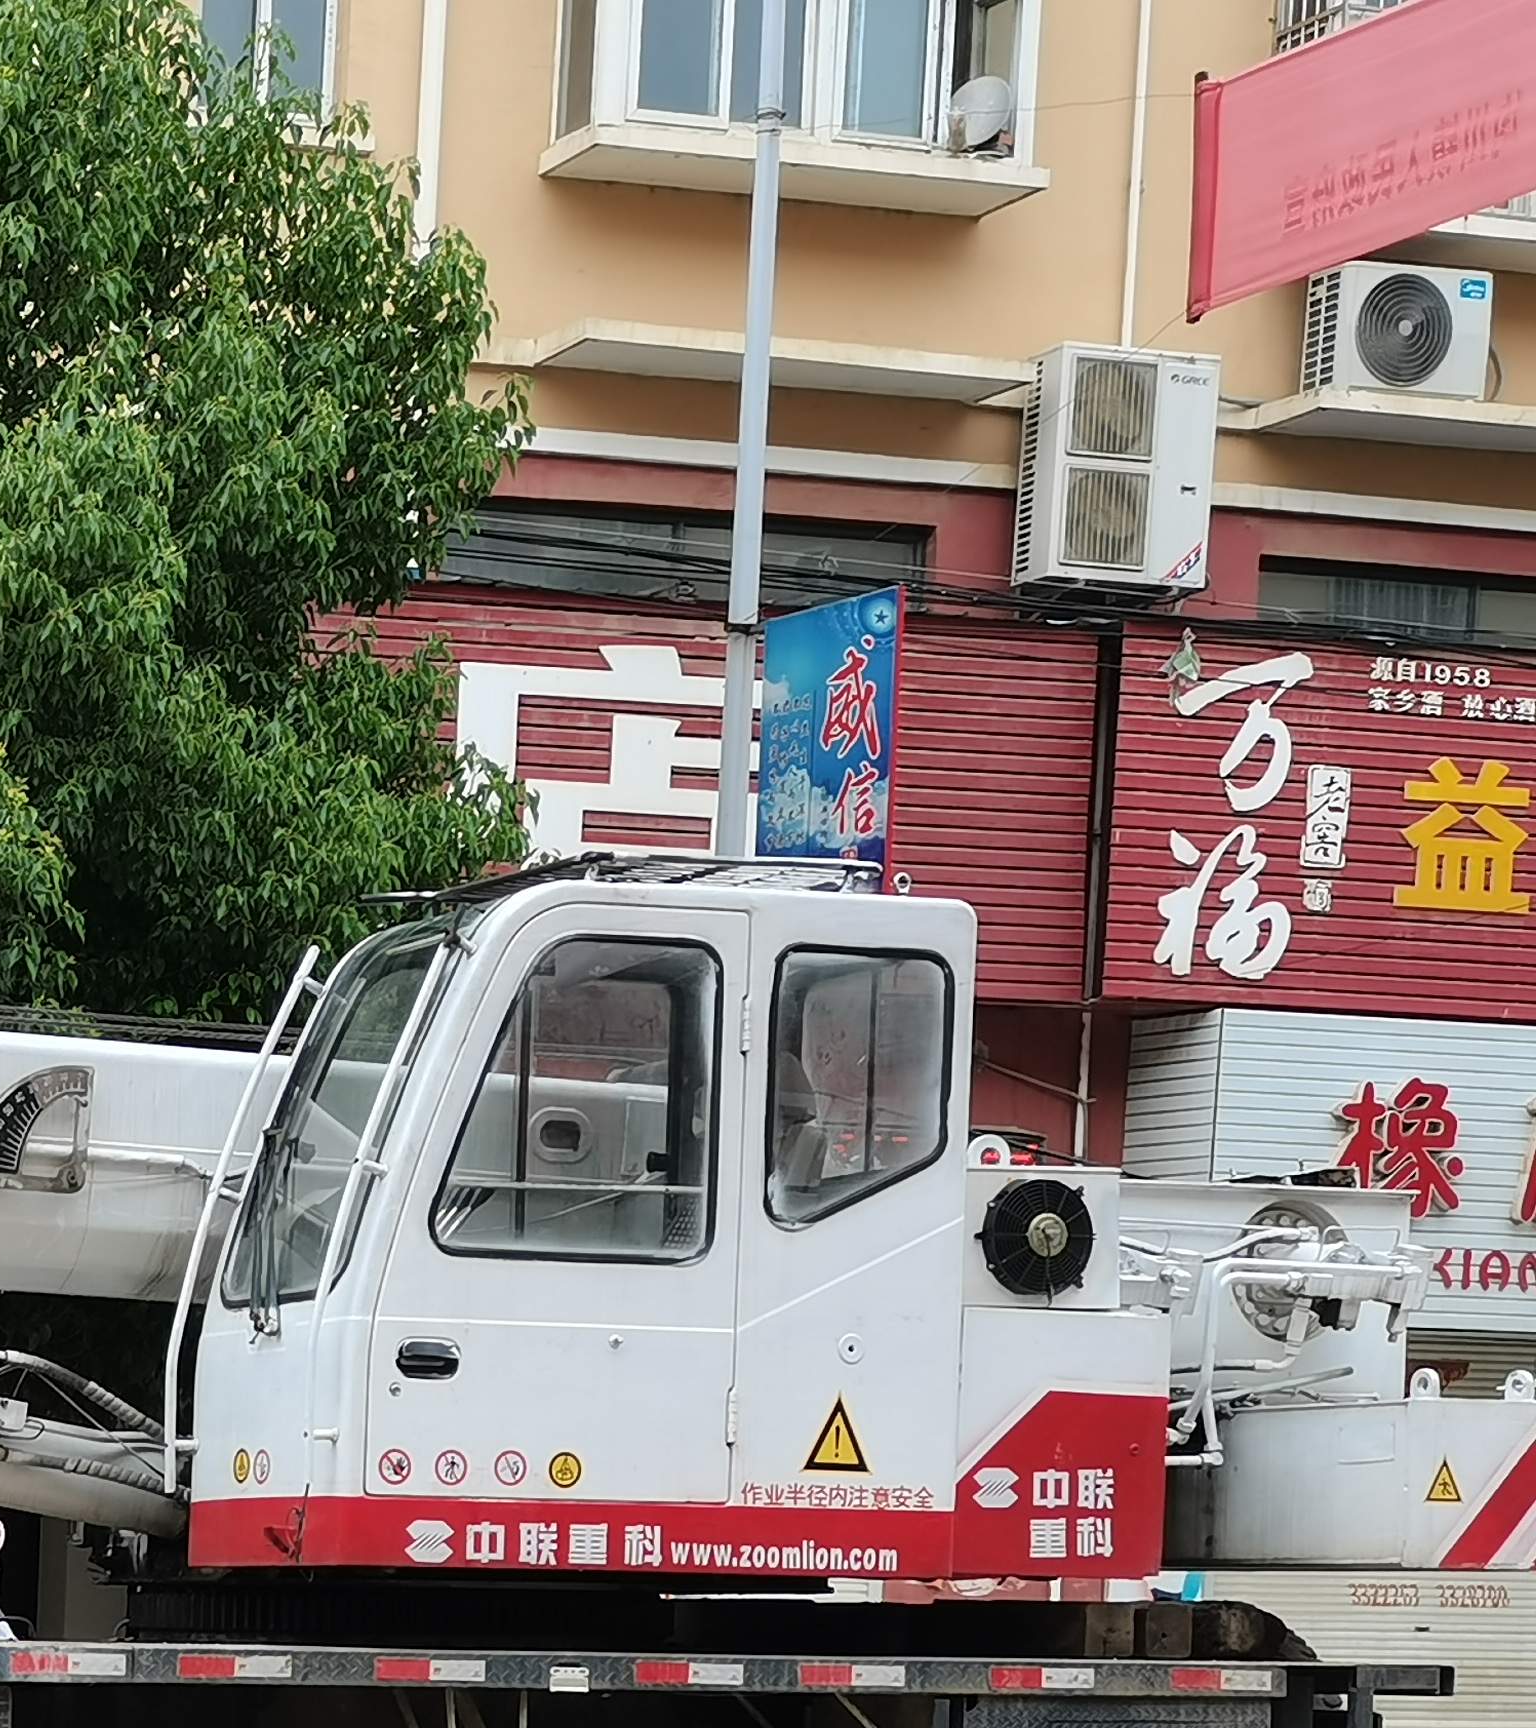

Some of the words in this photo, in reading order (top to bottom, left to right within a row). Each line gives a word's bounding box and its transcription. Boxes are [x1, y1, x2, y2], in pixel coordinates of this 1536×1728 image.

[1393, 757, 1531, 915] 益
[741, 1481, 935, 1511] 作业半径内注意安全
[1031, 1468, 1116, 1511] 中联
[465, 1521, 664, 1567] 中联重科
[670, 1539, 899, 1573] www.zoomlion.com
[1029, 1517, 1114, 1559] 重科
